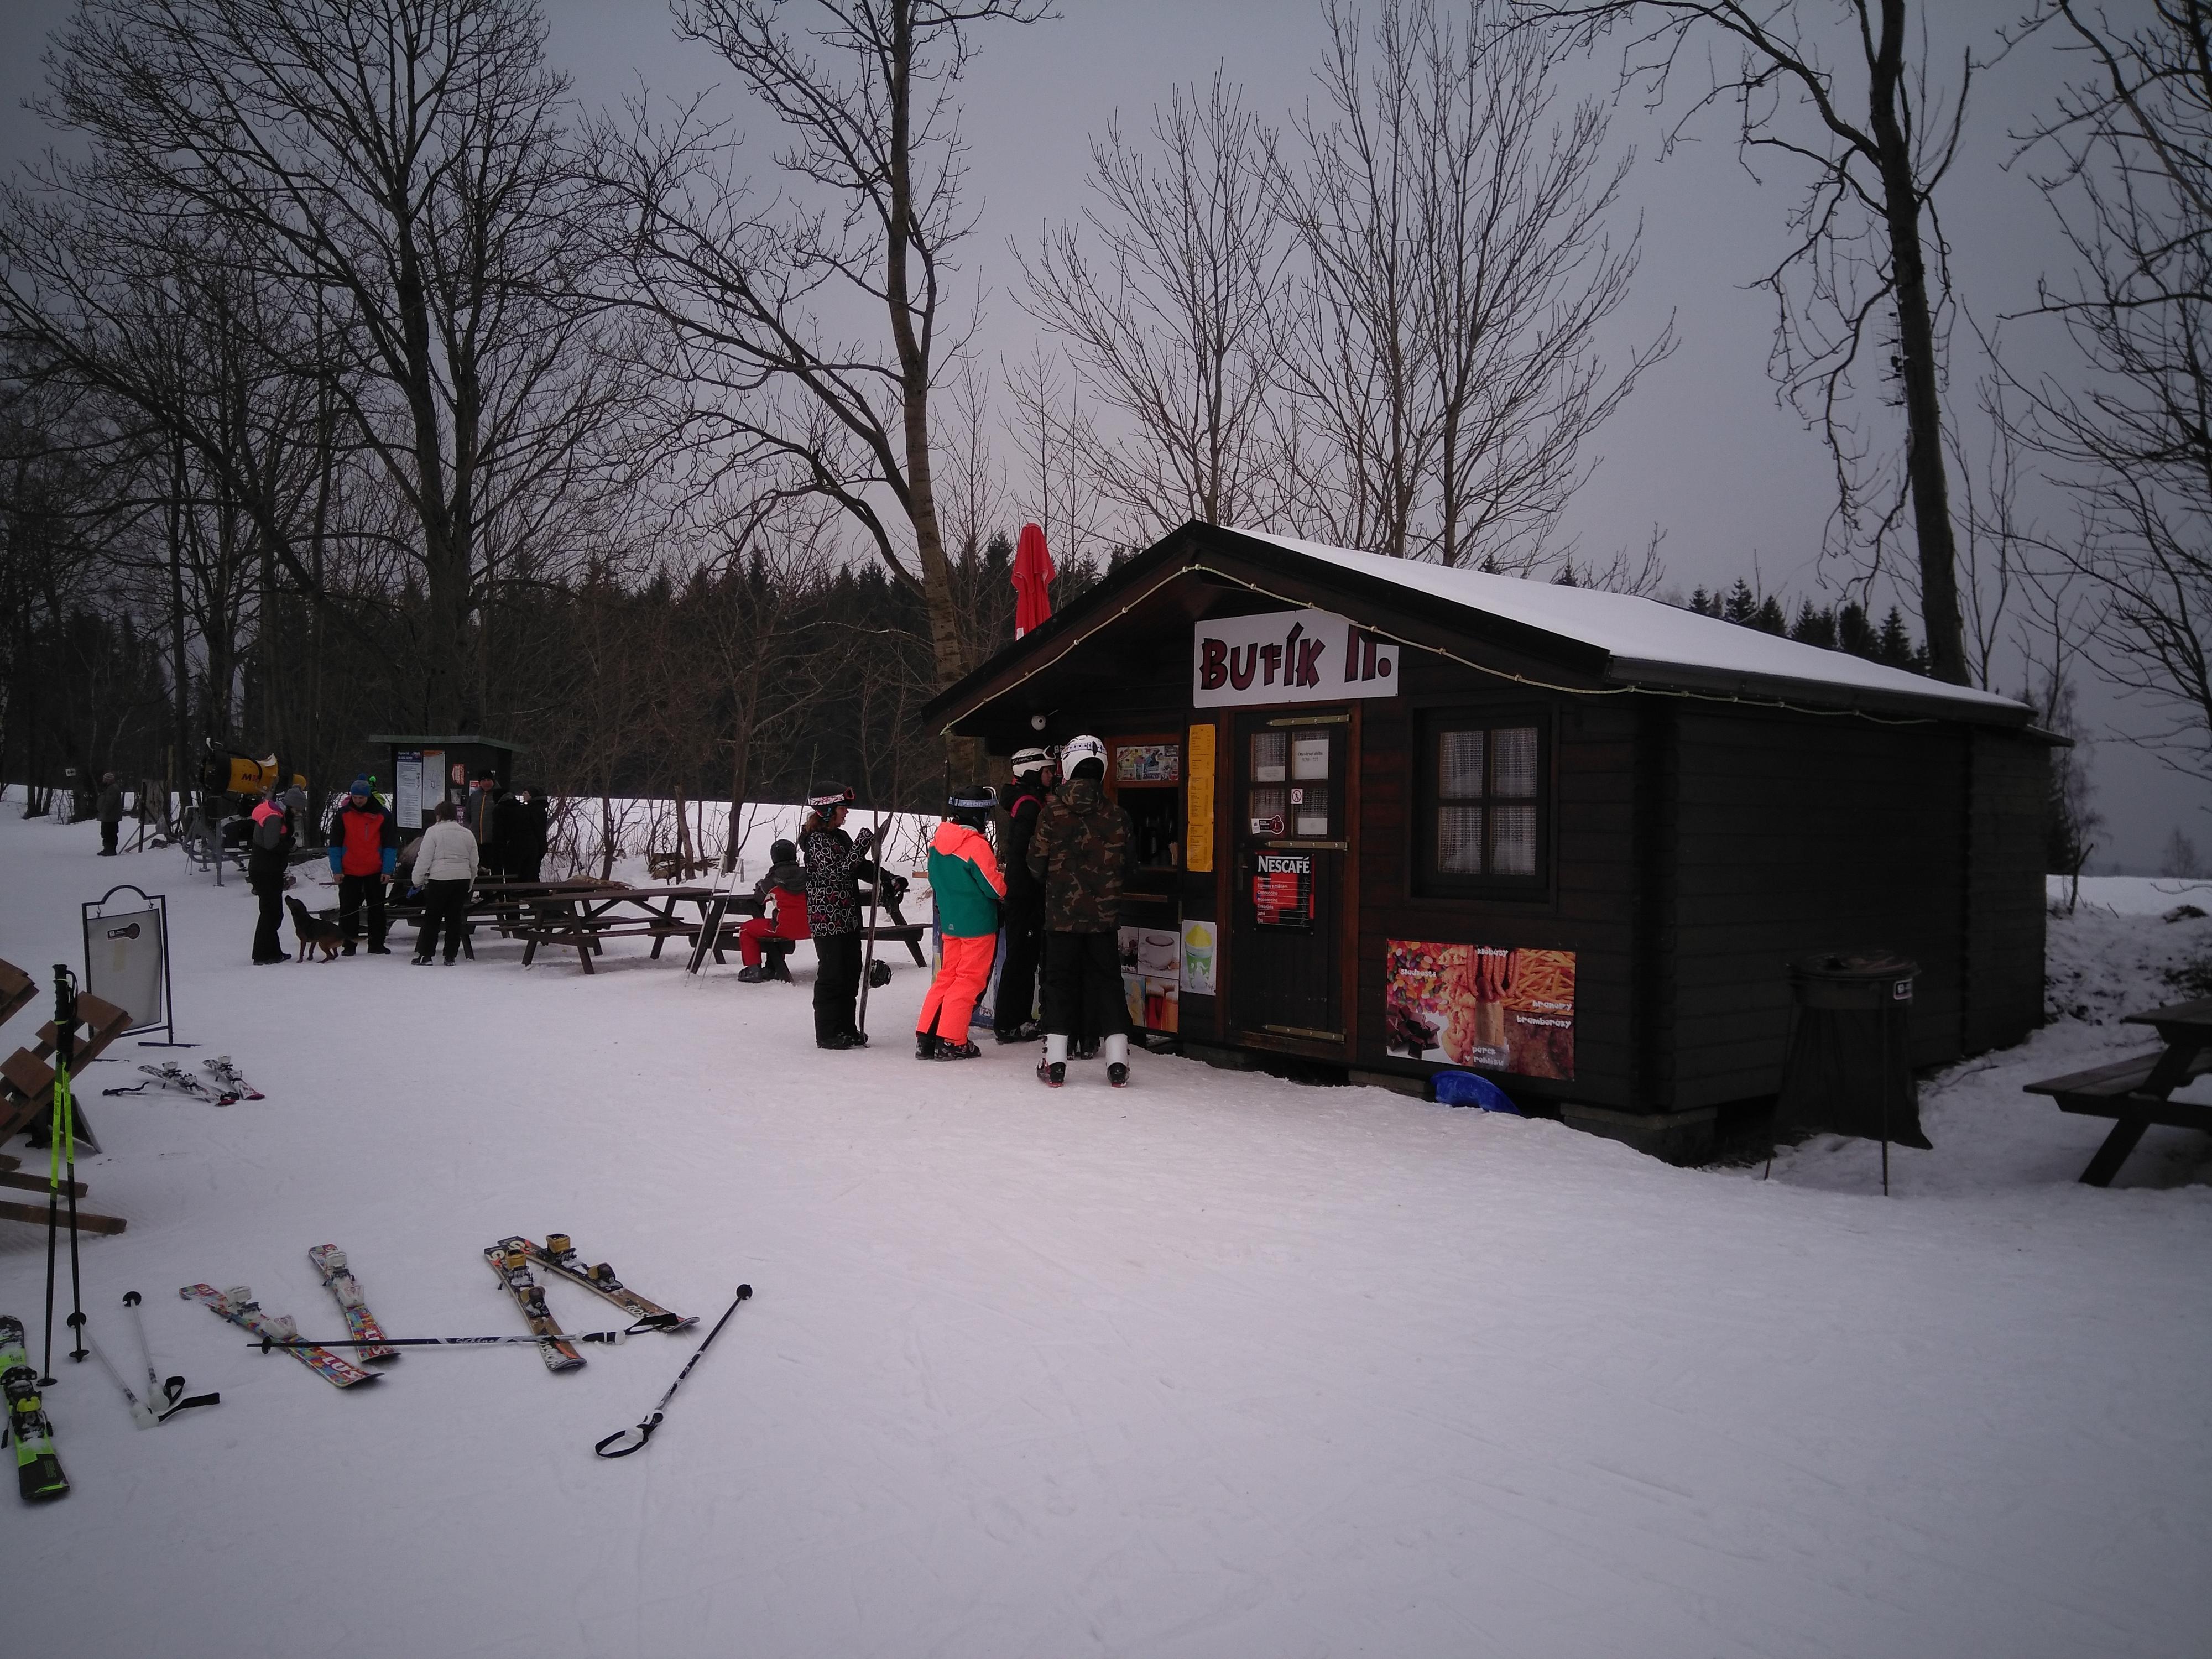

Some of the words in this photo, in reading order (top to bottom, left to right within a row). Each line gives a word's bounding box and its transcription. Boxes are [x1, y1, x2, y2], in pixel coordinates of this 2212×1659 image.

[1199, 622, 1326, 691] BUFÍK
[1258, 855, 1310, 874] NESCAFÉ
[1516, 1015, 1572, 1029] bramboráky
